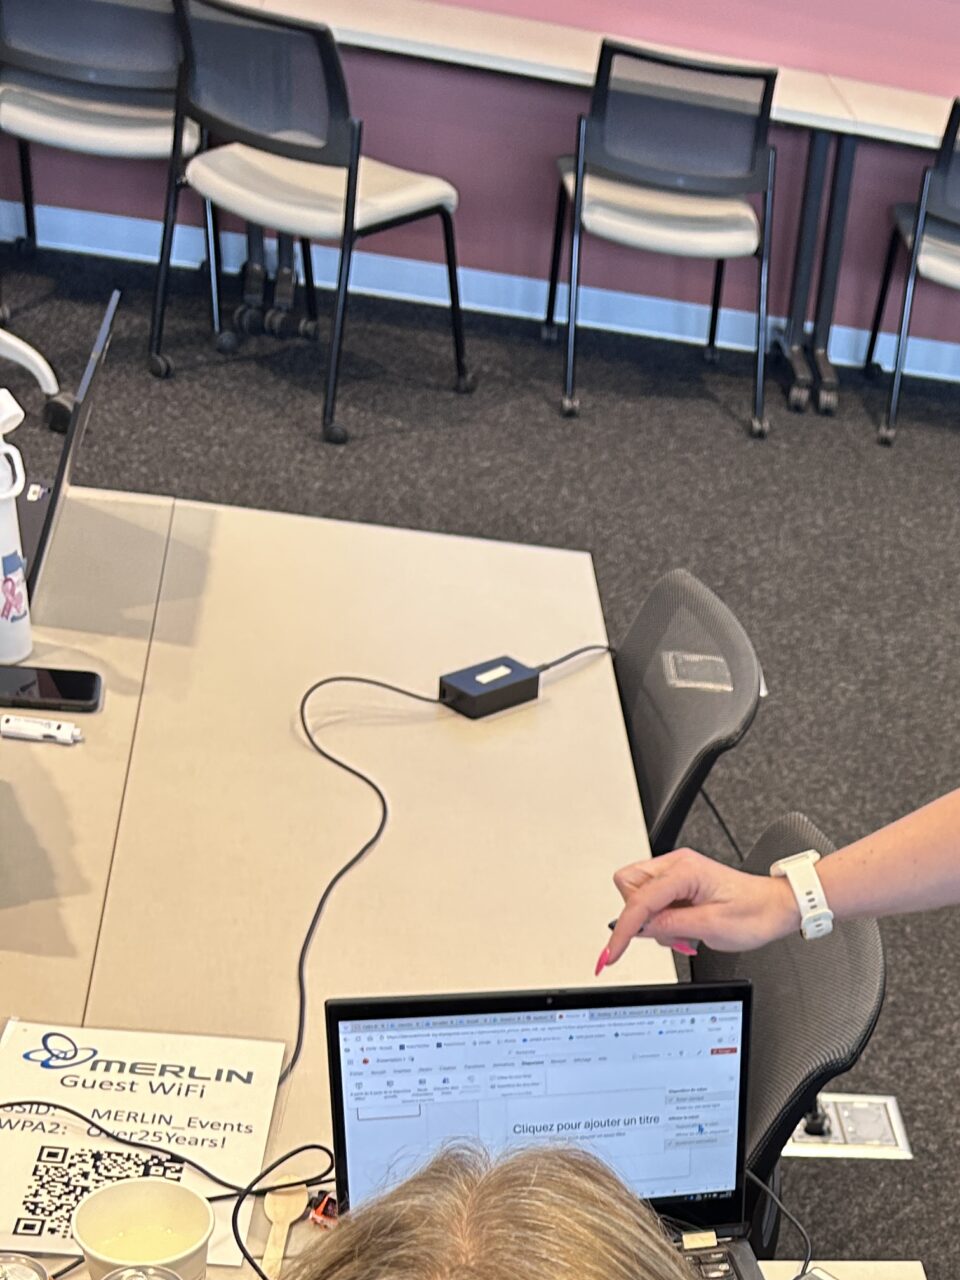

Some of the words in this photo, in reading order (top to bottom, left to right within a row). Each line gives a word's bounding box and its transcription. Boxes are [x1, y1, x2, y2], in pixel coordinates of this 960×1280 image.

[90, 1058, 254, 1085] MERLIN
[59, 1074, 138, 1094] Guest
[148, 1080, 206, 1099] WiFi
[0, 1117, 67, 1135] WPA2:
[91, 1108, 254, 1134] MERLIN_Events
[512, 1122, 555, 1135] Cliquez
[556, 1120, 582, 1132] pour
[583, 1117, 622, 1131] ajouter
[623, 1118, 637, 1127] un
[638, 1114, 661, 1125] titre
